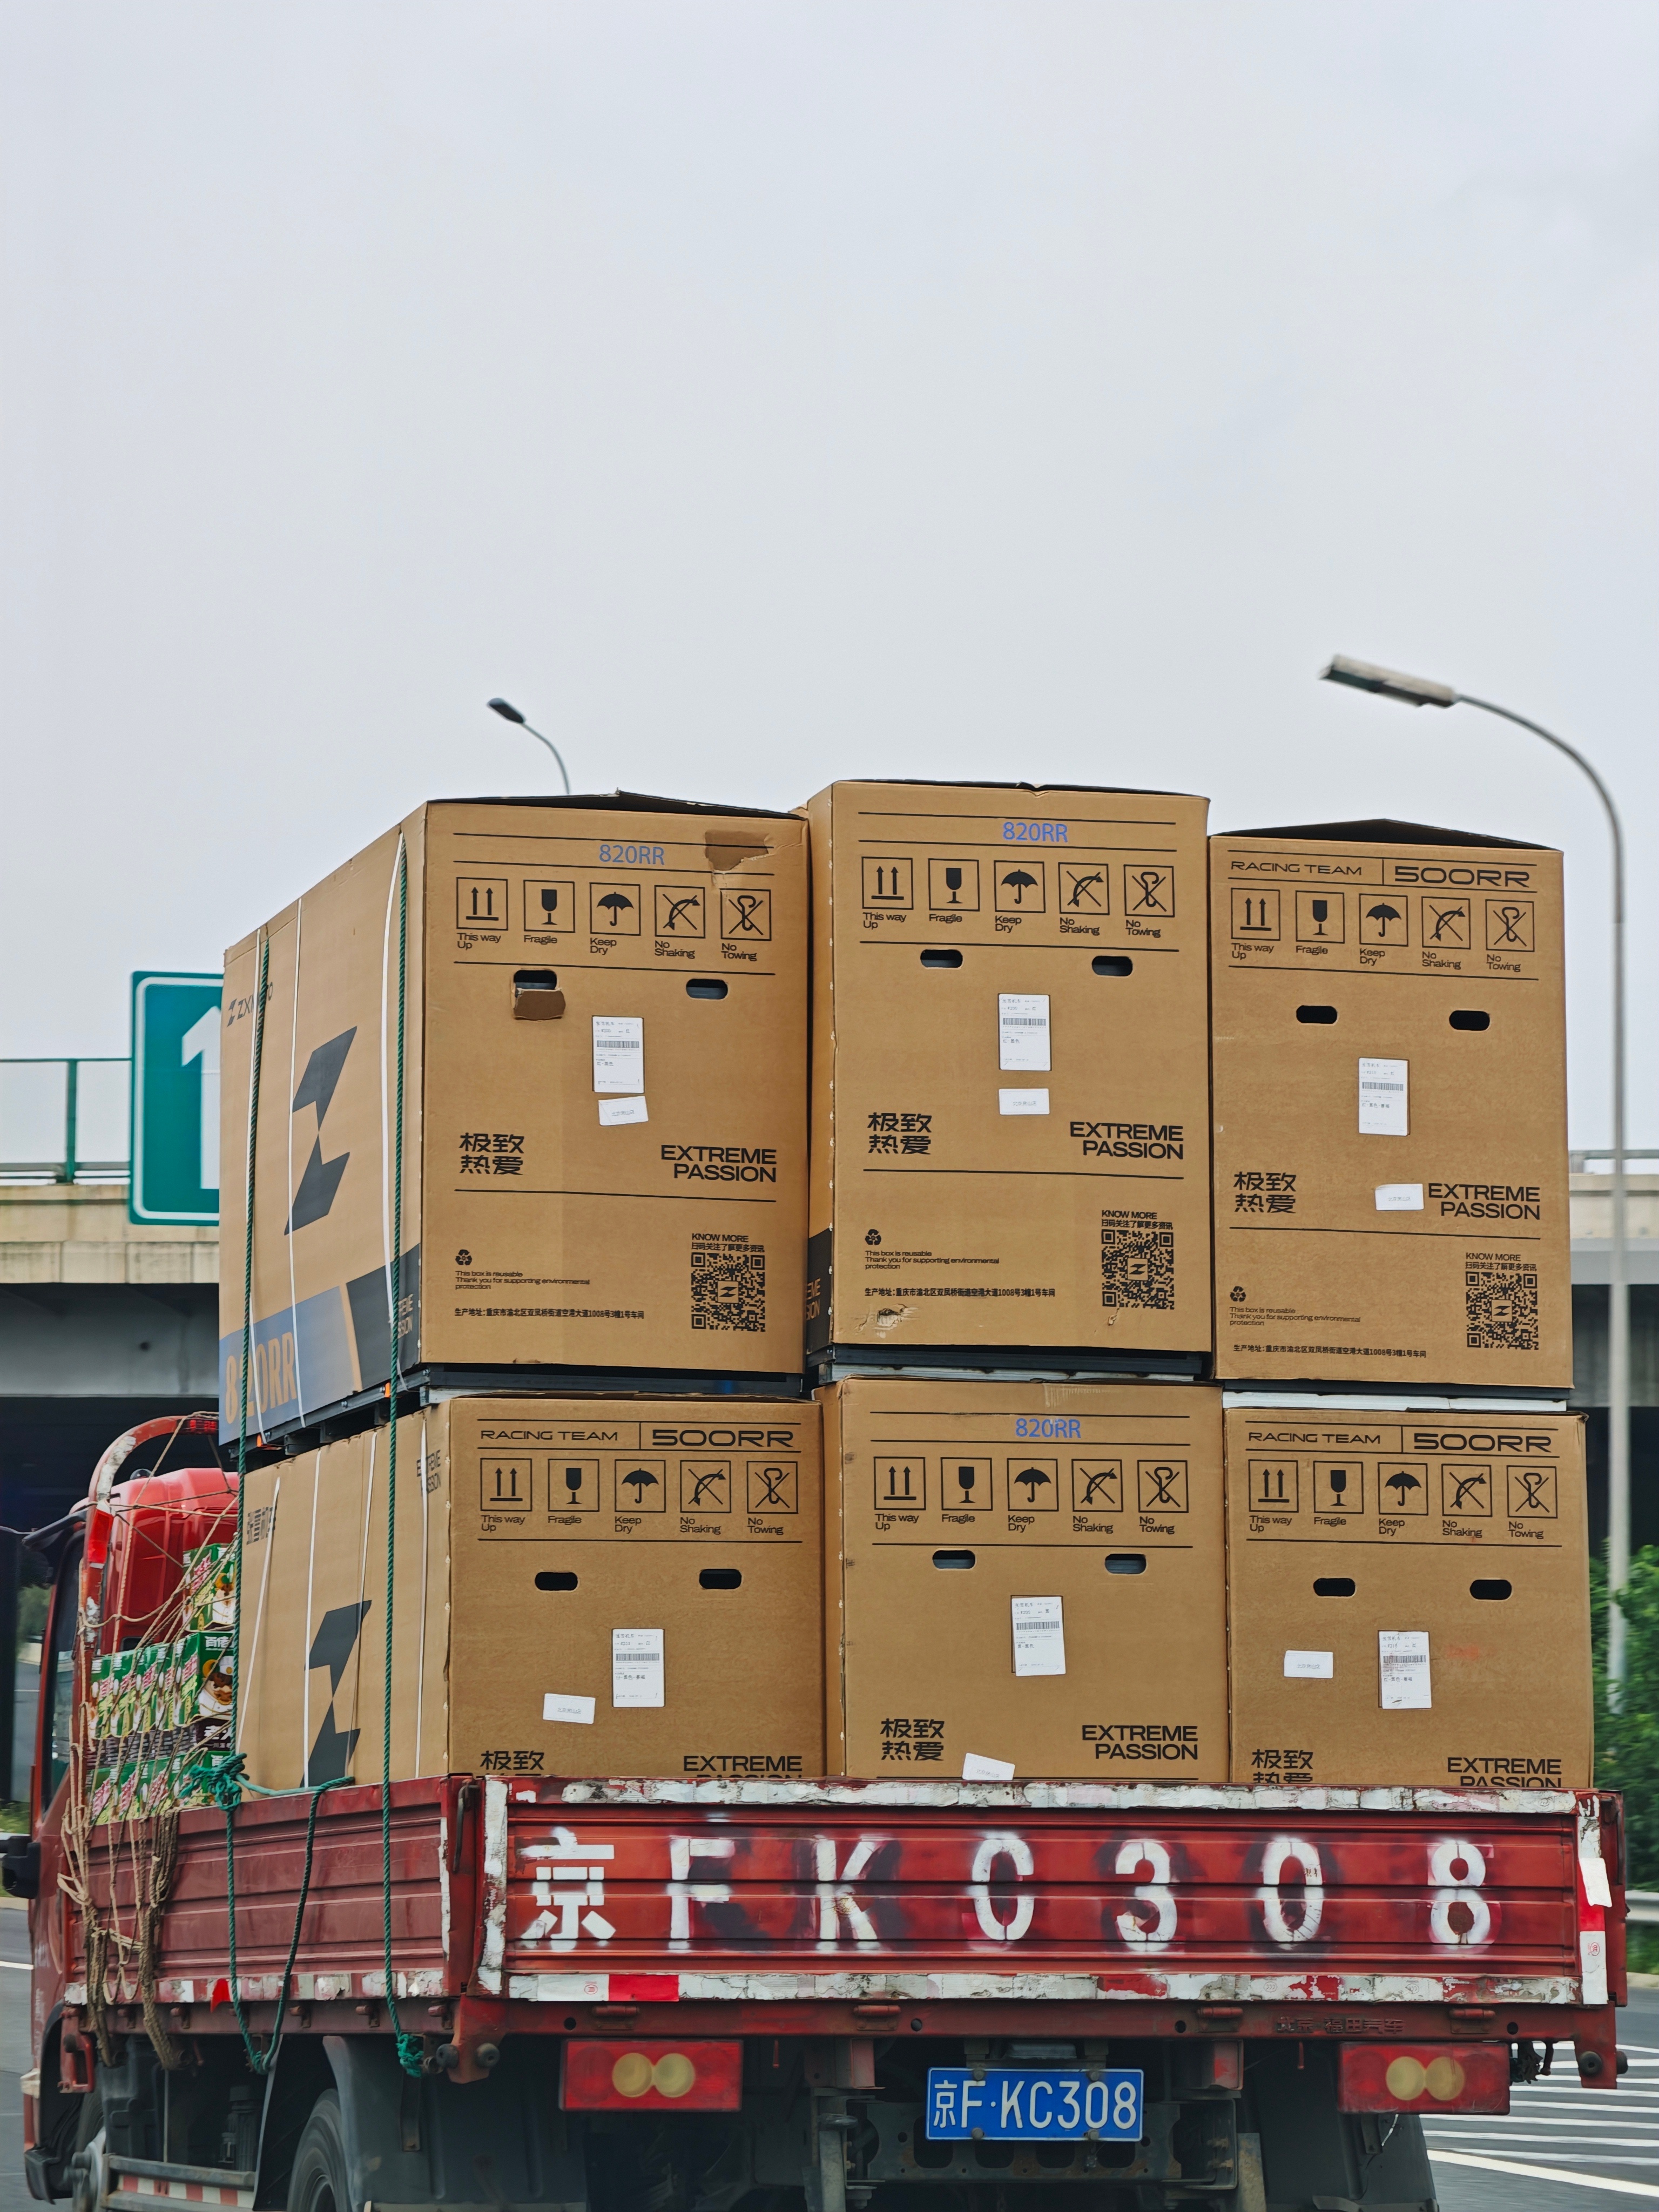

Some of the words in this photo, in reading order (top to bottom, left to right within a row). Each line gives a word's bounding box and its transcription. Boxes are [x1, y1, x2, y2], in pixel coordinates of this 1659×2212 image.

[1003, 821, 1068, 842] 820RR
[599, 845, 664, 865] 820RR
[1231, 861, 1300, 873] RACING
[1304, 865, 1361, 875] TEAM
[1394, 866, 1529, 887] 500RR
[862, 912, 884, 921] This
[929, 914, 962, 923] Fragile
[995, 915, 1022, 926] Keep
[864, 921, 878, 929] Up
[1060, 918, 1075, 926] No
[995, 924, 1013, 933] Dry
[1060, 926, 1100, 936] Shaking
[1125, 928, 1161, 938] Towing
[457, 933, 478, 941] This
[524, 935, 557, 945] Fragile
[457, 941, 473, 950] Up
[590, 938, 617, 947] Keep
[590, 946, 608, 955] Dry
[655, 948, 695, 959] Shaking
[1231, 943, 1252, 952] This
[1254, 946, 1274, 954] way
[1296, 946, 1328, 955] Fragile
[1360, 949, 1385, 958] Keep
[721, 951, 757, 961] Towing
[1232, 952, 1246, 960] Up
[1487, 954, 1501, 962] No
[1360, 957, 1377, 966] Dry
[1422, 960, 1461, 970] Shaking
[1486, 962, 1521, 972] Towing
[867, 1112, 932, 1132] 极致
[1070, 1122, 1183, 1141] EXTREME
[459, 1132, 524, 1154] 极致
[868, 1134, 931, 1155] 热爱
[662, 1145, 777, 1165] EXTREME
[1083, 1141, 1183, 1159] PASSION
[460, 1155, 523, 1175] 热爱
[674, 1164, 776, 1182] PASSION
[1233, 1172, 1296, 1191] 极致
[1428, 1183, 1540, 1202] EXTREME
[1235, 1193, 1296, 1213] 热爱
[1131, 1211, 1157, 1219] MORE
[1441, 1202, 1540, 1220] PASSION
[1015, 1419, 1081, 1438] 820RR
[481, 1431, 552, 1440] RACING
[557, 1432, 617, 1440] TEAM
[652, 1429, 793, 1447] 500RR
[1249, 1432, 1318, 1442] RACING
[1321, 1434, 1380, 1444] TEAM
[1414, 1433, 1551, 1452] 500RR
[504, 1517, 525, 1525] way
[548, 1516, 582, 1525] Fragile
[615, 1516, 642, 1526] Keep
[898, 1515, 919, 1523] way
[942, 1514, 975, 1524] Fragile
[1008, 1515, 1035, 1525] Keep
[1249, 1515, 1270, 1523] This
[1272, 1518, 1292, 1526] way
[1314, 1517, 1346, 1527] Fragile
[1379, 1519, 1405, 1528] Keep
[482, 1523, 496, 1533] Up
[615, 1525, 633, 1534] Dry
[680, 1525, 721, 1535] Shaking
[747, 1526, 784, 1535] Towing
[875, 1522, 891, 1532] Up
[1008, 1523, 1026, 1533] Dry
[1073, 1524, 1113, 1534] Shaking
[1139, 1525, 1175, 1535] Towing
[1250, 1524, 1264, 1533] Up
[1379, 1527, 1396, 1536] Dry
[1442, 1528, 1482, 1538] Shaking
[1508, 1529, 1543, 1539] Towing
[880, 1718, 945, 1738] 极致
[1082, 1725, 1198, 1741] EXTREME
[881, 1741, 943, 1761] 热爱
[1095, 1744, 1197, 1760] PASSION
[480, 1751, 544, 1770] 极致
[684, 1756, 802, 1771] EXTREME
[1251, 1749, 1313, 1769] 极致
[1448, 1757, 1562, 1775] EXTREME
[933, 2080, 1136, 2129] 京F·KC308
